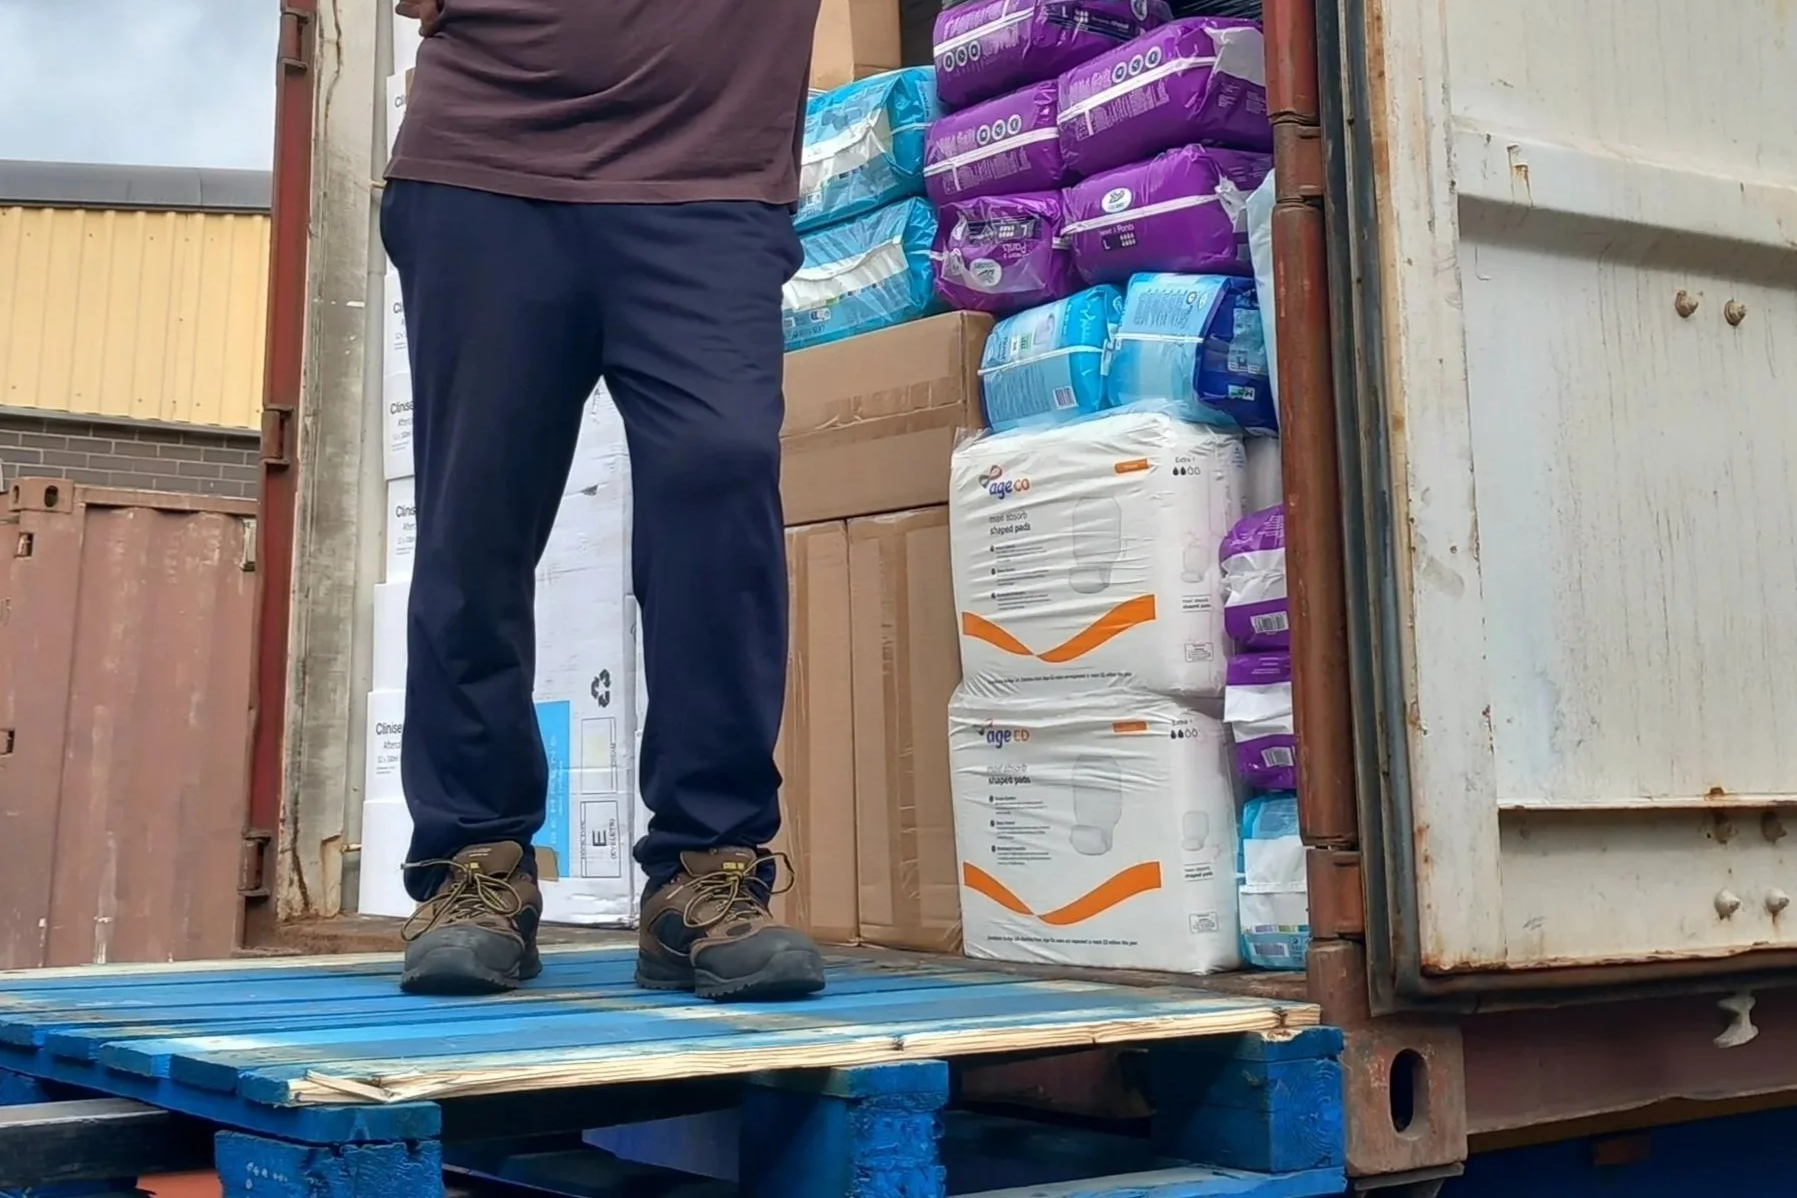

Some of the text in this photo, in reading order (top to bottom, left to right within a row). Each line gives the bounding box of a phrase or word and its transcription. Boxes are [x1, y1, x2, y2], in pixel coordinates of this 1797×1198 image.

[1102, 239, 1111, 250] L
[375, 721, 403, 736] Clinise
[591, 829, 607, 847] E
